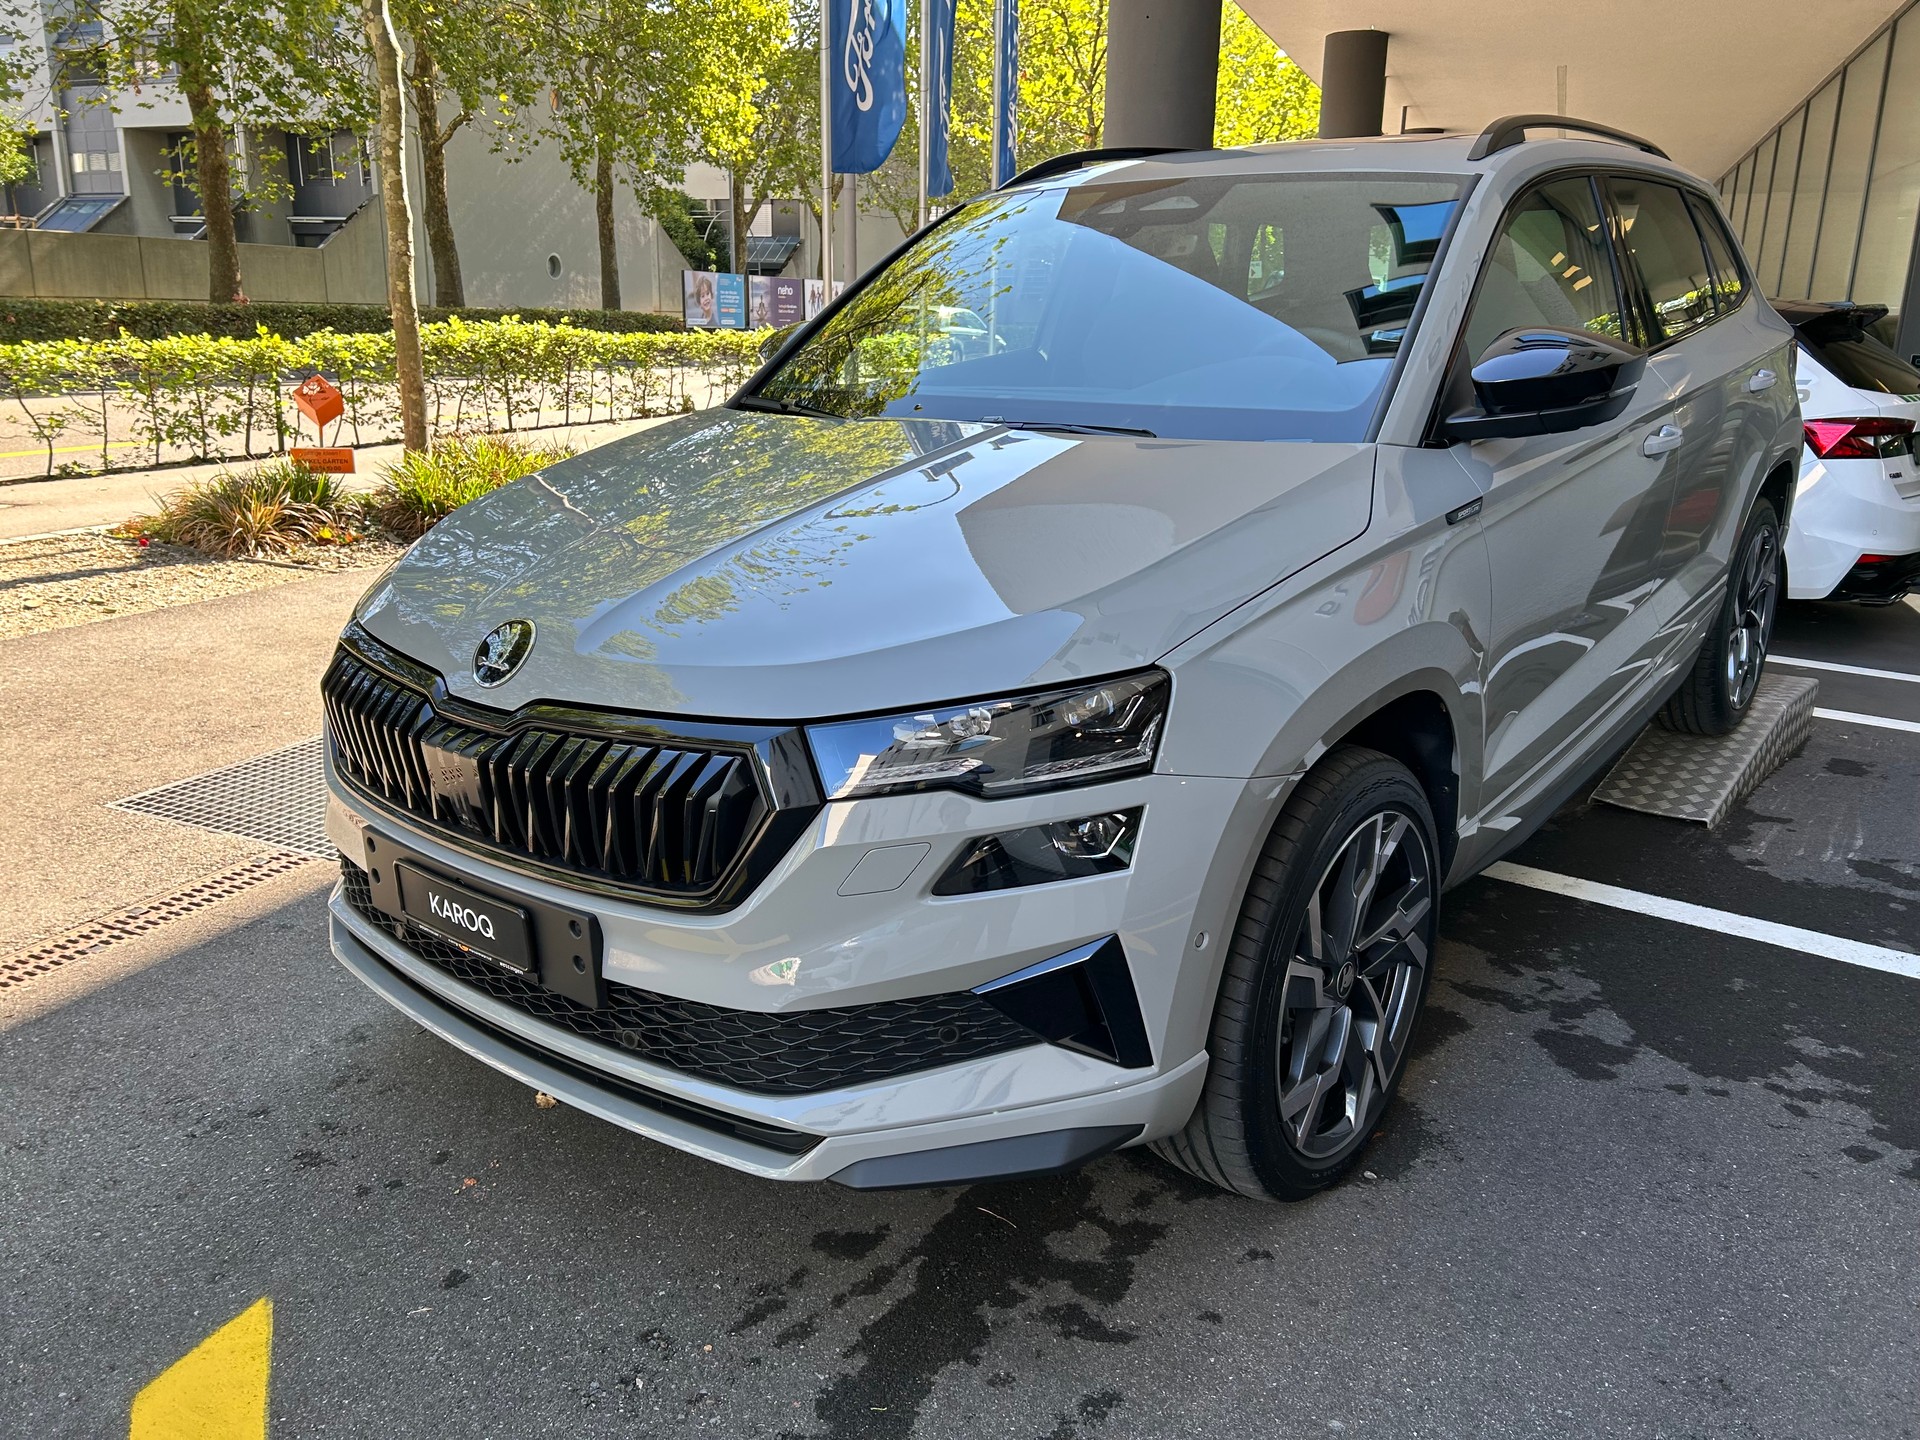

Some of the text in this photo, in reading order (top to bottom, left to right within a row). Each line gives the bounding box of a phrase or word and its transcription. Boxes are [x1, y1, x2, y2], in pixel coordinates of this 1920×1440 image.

[844, 0, 876, 112] For
[777, 285, 793, 296] neho
[428, 892, 496, 941] KAROQ
